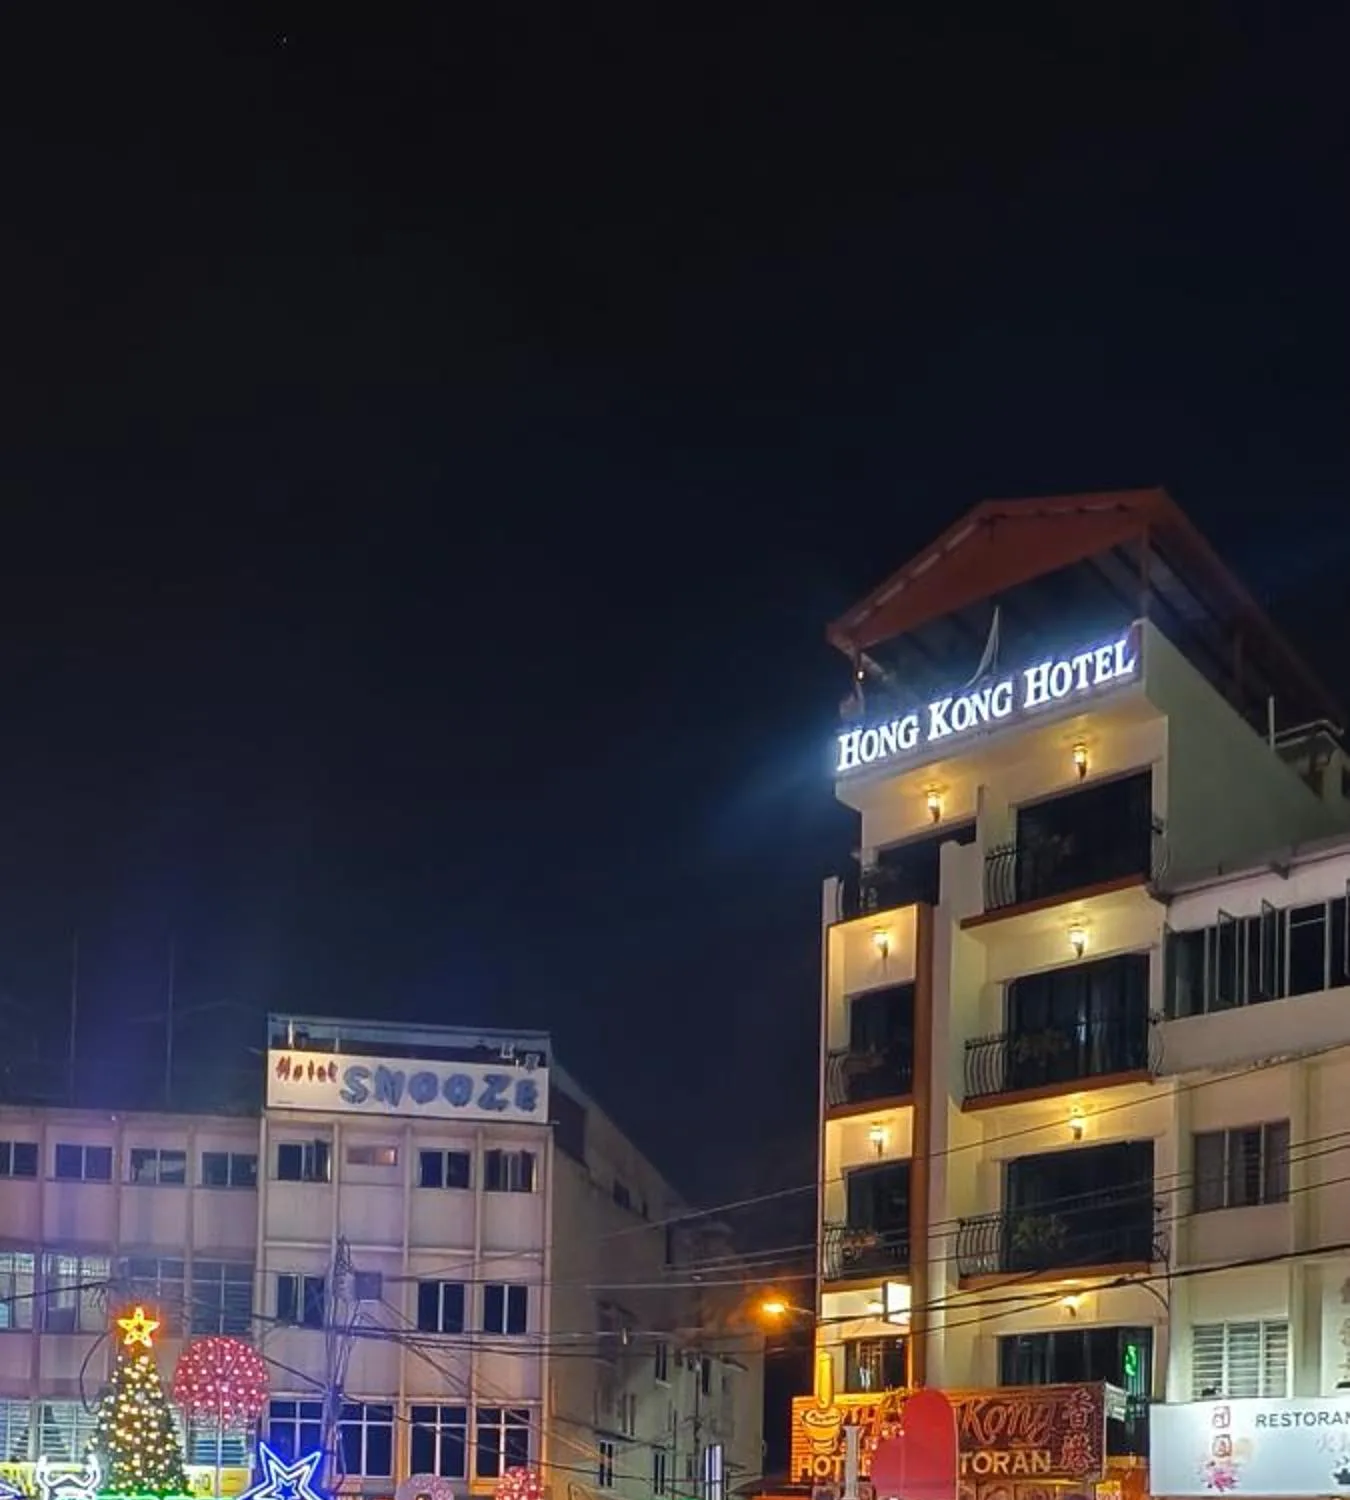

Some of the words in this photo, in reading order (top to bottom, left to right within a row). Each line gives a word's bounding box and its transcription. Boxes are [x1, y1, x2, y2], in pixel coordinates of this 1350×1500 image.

[836, 714, 920, 772] HONG
[927, 680, 1013, 742] KONG
[1023, 639, 1136, 709] HOTEL
[339, 1064, 539, 1113] SNOOZE
[959, 1450, 1050, 1475] TORAN
